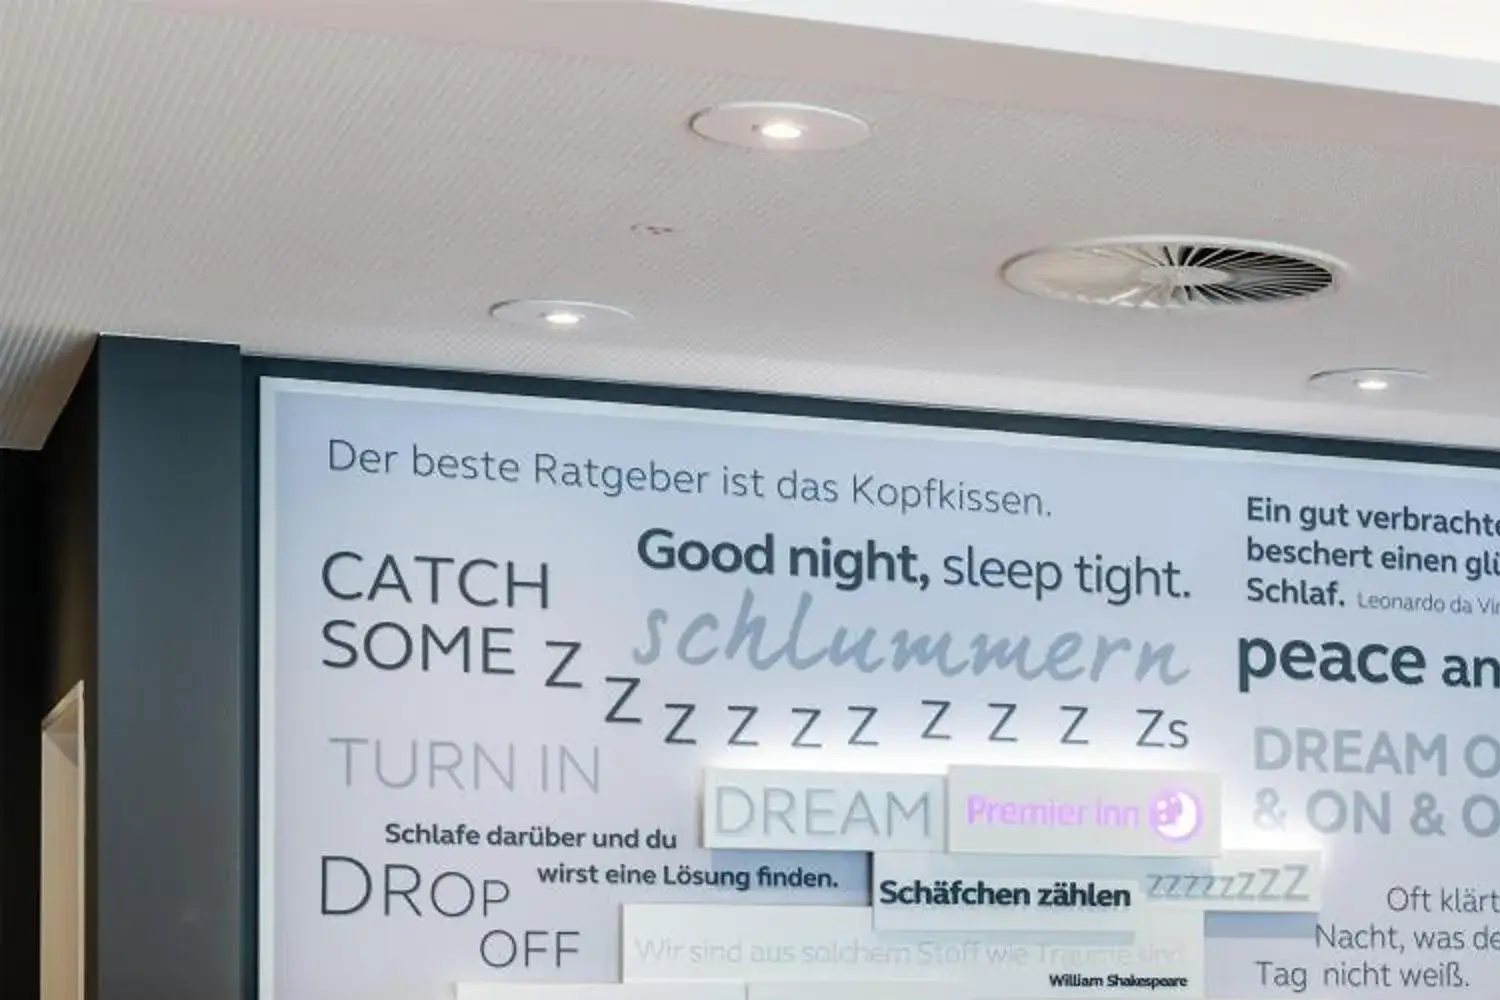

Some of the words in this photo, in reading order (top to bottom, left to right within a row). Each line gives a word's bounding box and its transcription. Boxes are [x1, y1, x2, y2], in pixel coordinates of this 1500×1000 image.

[329, 439, 398, 474] Der
[412, 444, 520, 482] beste
[535, 454, 708, 497] Ratgeber
[723, 466, 764, 498] ist
[777, 470, 838, 502] das
[853, 474, 1052, 517] Kopfkissen.
[1247, 496, 1291, 523] Ein
[1300, 503, 1349, 531] gut
[637, 528, 774, 574] Good
[789, 537, 930, 591] night,
[944, 546, 1062, 600] sleep
[1074, 555, 1191, 606] tight.
[1247, 537, 1372, 569] beschert
[1381, 546, 1456, 574] einen
[321, 551, 549, 609] CATCH
[1247, 578, 1345, 608] Schlaf.
[1358, 591, 1445, 614] Leonardo
[1451, 596, 1472, 615] da
[322, 619, 515, 674] SOME
[633, 587, 1190, 685] schlummern
[1239, 636, 1426, 692] peace
[329, 738, 515, 792] TURN
[542, 743, 600, 794] IN
[1254, 726, 1447, 777] DREAM
[715, 786, 931, 838] DREAM
[966, 794, 1088, 827] Premier
[1096, 803, 1139, 829] Inn
[1254, 786, 1287, 833] &
[1306, 789, 1390, 836] ON
[1410, 791, 1446, 837] &
[385, 823, 481, 846] Schlafe
[487, 826, 587, 848] darüber
[593, 828, 639, 849] und
[646, 828, 677, 850] du
[320, 855, 510, 918] DROP
[537, 863, 601, 884] wirst
[605, 866, 657, 886] eine
[663, 865, 750, 891] Lösung
[757, 866, 839, 889] finden.
[880, 880, 1030, 907] Schäfchen
[1038, 881, 1131, 908] zählen
[1386, 885, 1432, 913] Oft
[1440, 887, 1500, 913] klärt
[479, 929, 580, 969] OFF
[1315, 923, 1405, 954] Nacht,
[1413, 929, 1465, 950] was
[1049, 973, 1103, 988] William
[1106, 974, 1188, 990] Shakespeare
[1254, 961, 1307, 993] Tag
[1323, 961, 1391, 987] nicht
[1400, 961, 1470, 988] weiß.
